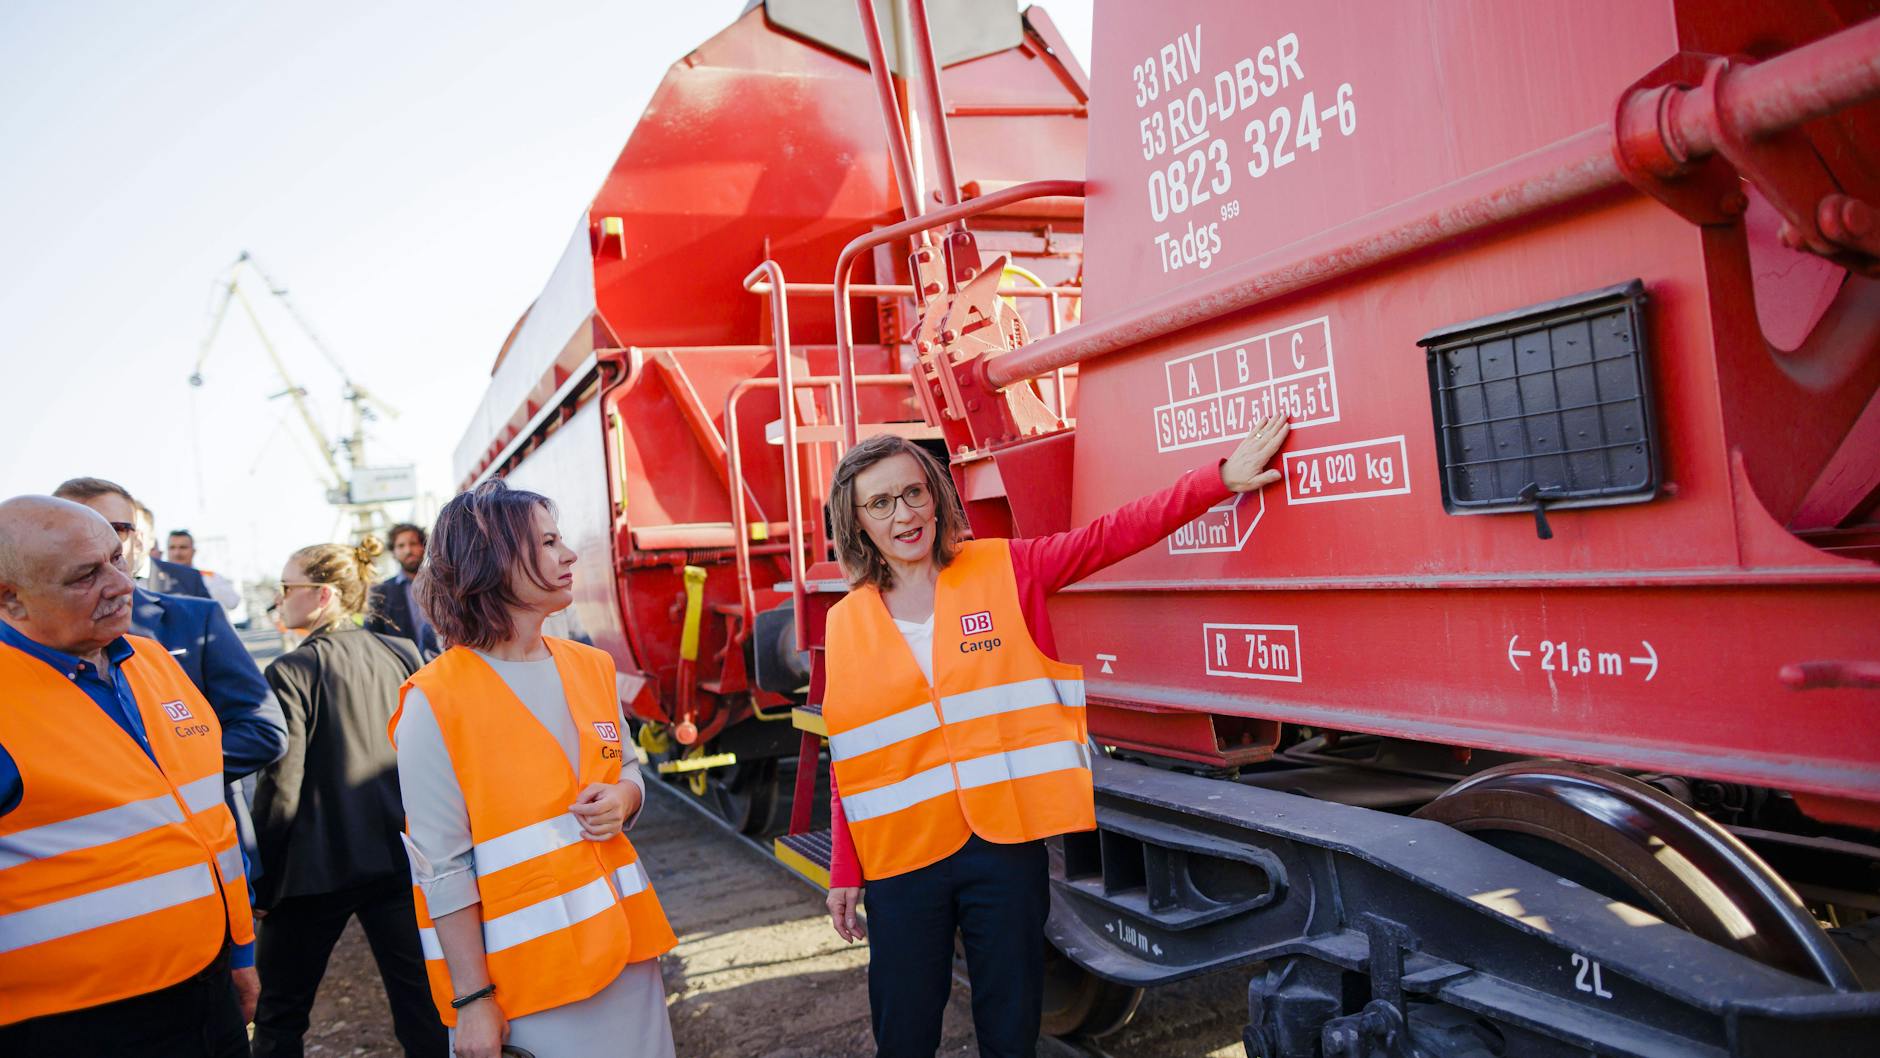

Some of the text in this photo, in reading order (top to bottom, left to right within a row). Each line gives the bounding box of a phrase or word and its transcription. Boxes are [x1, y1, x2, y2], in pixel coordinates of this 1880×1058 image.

[1133, 23, 1201, 108] 33 RIV
[1140, 32, 1304, 161] 53 RO-DBSR
[1148, 82, 1356, 223] 0823 324-6
[1154, 199, 1240, 273] Tadgs 959
[1188, 332, 1305, 397] A B C
[1161, 412, 1172, 444] S
[1296, 453, 1394, 495] 24 020 kg
[963, 613, 991, 634] DB
[960, 638, 1001, 653] Cargo
[1216, 633, 1289, 670] R 75m
[1540, 640, 1622, 676] 21,6 m
[163, 702, 191, 720] DB
[175, 725, 210, 738] Cargo
[595, 724, 617, 740] DB
[1571, 953, 1613, 999] 2L
